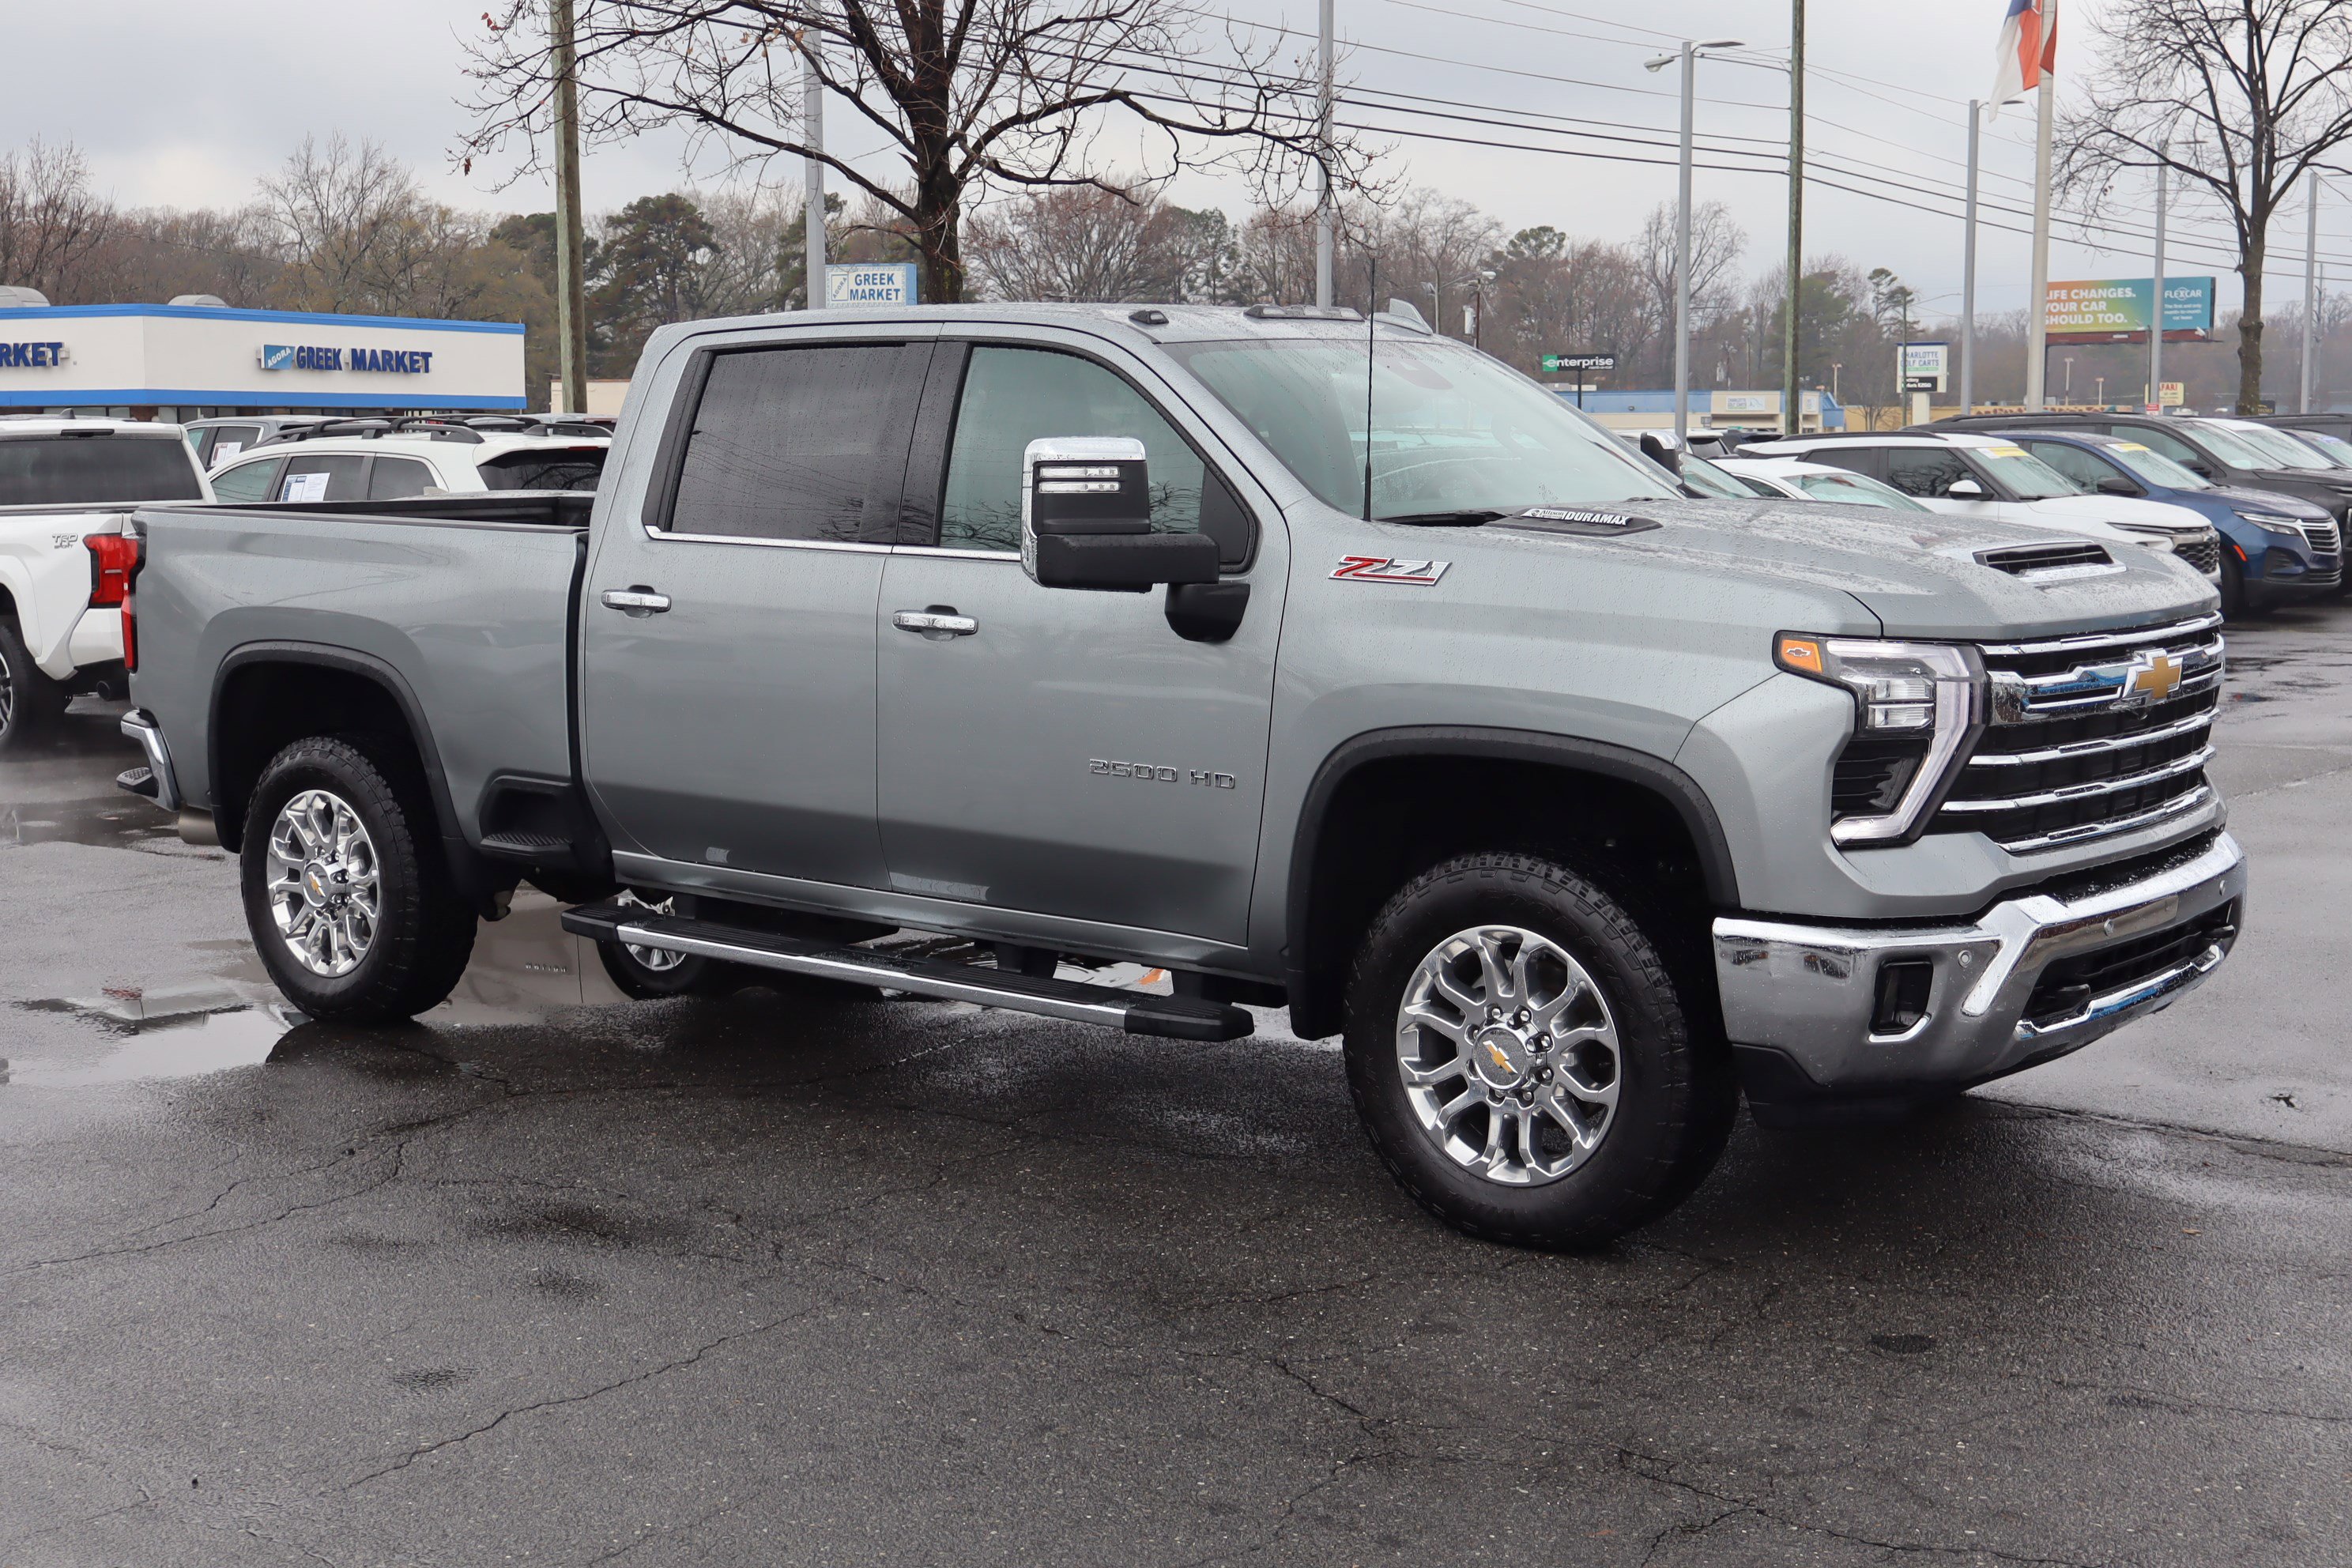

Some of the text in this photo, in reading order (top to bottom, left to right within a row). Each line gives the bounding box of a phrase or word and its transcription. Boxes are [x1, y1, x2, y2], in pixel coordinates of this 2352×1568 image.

[854, 273, 895, 286] GREEK
[832, 277, 847, 299] AGORA
[850, 288, 901, 300] MARKET
[2045, 287, 2136, 300] IFE CHANGES.
[2164, 288, 2202, 300] FLEXCAR
[2080, 300, 2107, 311] CAR
[2096, 313, 2128, 324] TOO.
[267, 345, 433, 374] AGORA GREEK MARKET
[1544, 356, 1614, 368] enterprise
[1565, 511, 1630, 526] DURAMAX
[52, 533, 78, 545] TRD
[1328, 555, 1453, 586] Z71
[1089, 758, 1236, 789] 2500 HD
